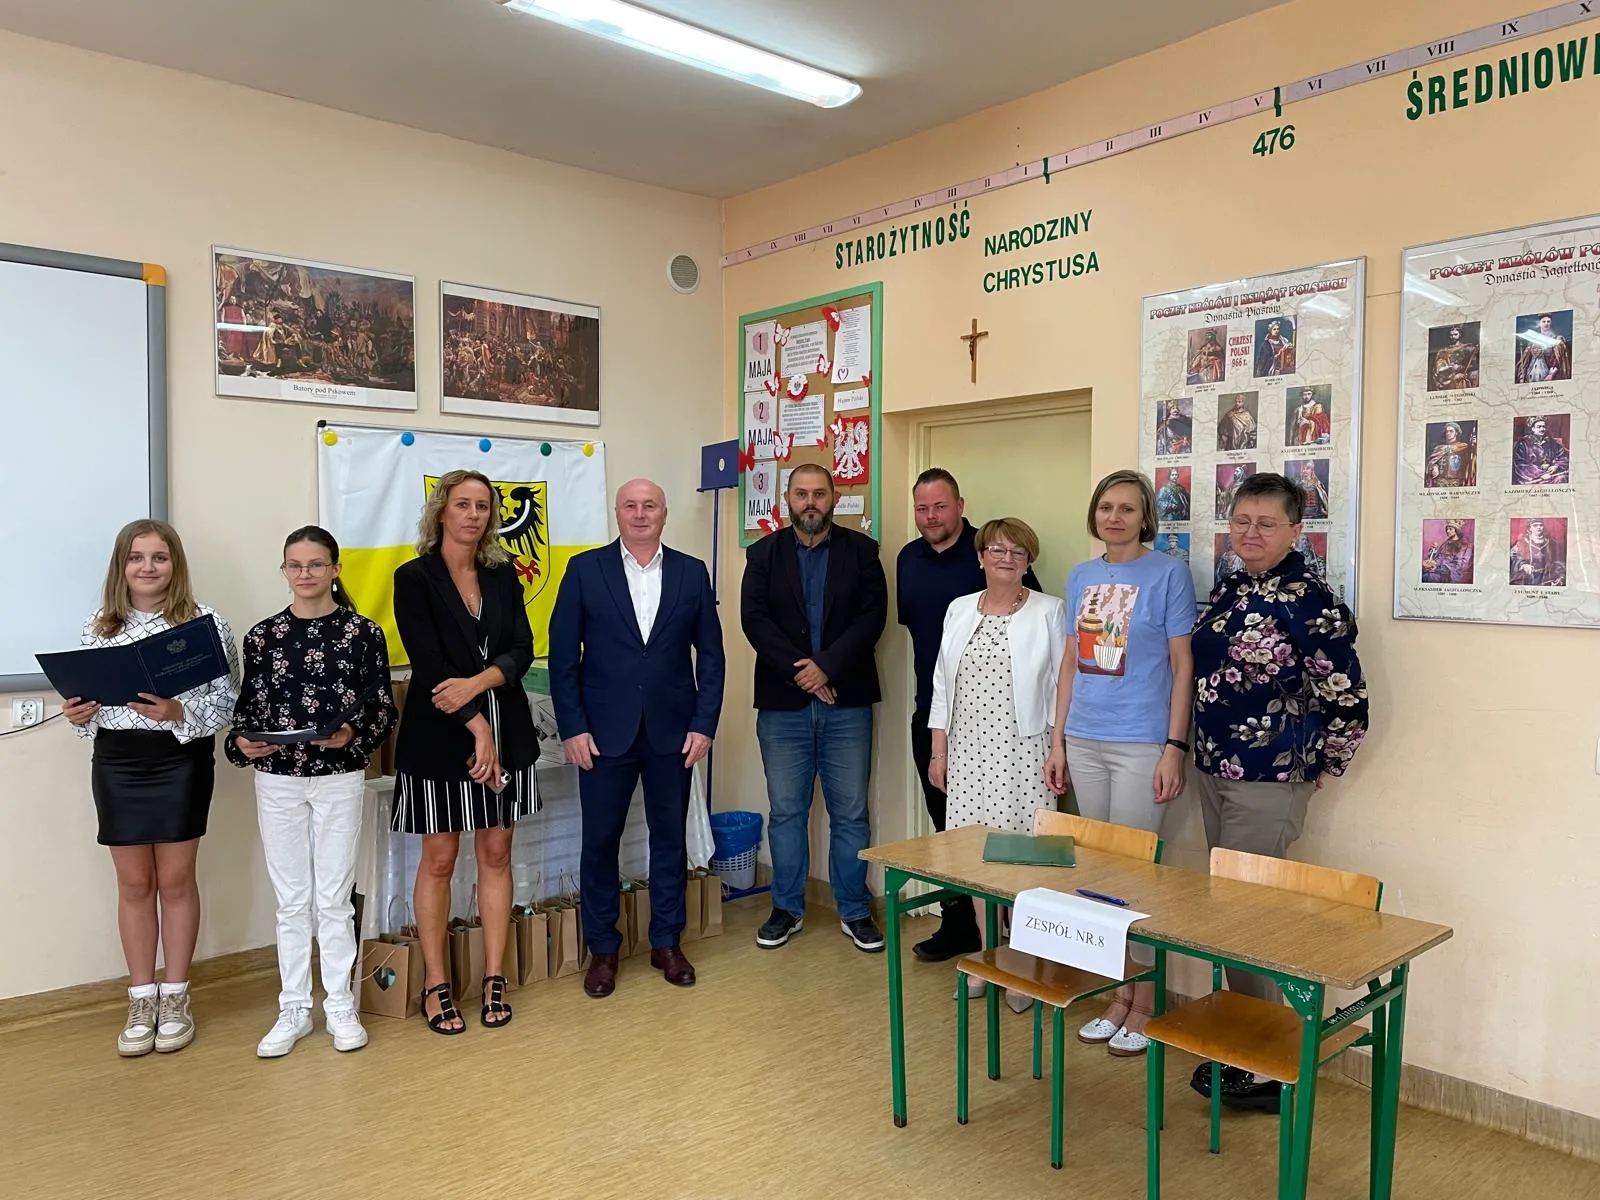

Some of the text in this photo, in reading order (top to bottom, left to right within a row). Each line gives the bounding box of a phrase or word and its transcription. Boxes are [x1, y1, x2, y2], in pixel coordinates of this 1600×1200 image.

[822, 225, 833, 234] VII
[852, 217, 861, 226] VI
[947, 188, 957, 198] III
[984, 178, 991, 188] II
[1106, 140, 1114, 151] II
[1149, 126, 1162, 138] III
[1198, 111, 1211, 124] IV
[1254, 96, 1263, 107] V
[1308, 78, 1323, 91] VI
[1365, 60, 1386, 75] VII
[1426, 40, 1455, 57] VIII
[1501, 20, 1520, 36] IX
[1579, 0, 1593, 16] X
[1252, 124, 1295, 157] 476
[835, 200, 970, 270] STAROŻYTNOŚĆ
[984, 209, 1093, 257] NARODZINY
[983, 251, 1100, 293] CHRYSTUSA
[1429, 259, 1494, 280] POCZET
[1498, 246, 1575, 269] KRÓLÓW
[1484, 268, 1536, 286] Dynastia
[1150, 304, 1187, 320] POCZET
[1188, 295, 1232, 313] KRÓLÓW
[1240, 286, 1287, 305] KSIĄŻĄT
[1288, 277, 1348, 297] POLSKICH
[1204, 303, 1281, 324] Dynastia Piastów
[758, 333, 763, 351] 1
[1228, 334, 1253, 346] CHRZEST
[1230, 346, 1250, 356] POLSKI
[748, 358, 772, 379] MAJA
[1231, 358, 1242, 368] 966
[293, 384, 313, 393] Batory
[327, 387, 356, 396] Pskowem
[758, 402, 764, 420] 2
[748, 428, 773, 446] MAJA
[758, 473, 764, 490] 3
[748, 499, 772, 516] MAJA
[1075, 928, 1105, 948] NR.8
